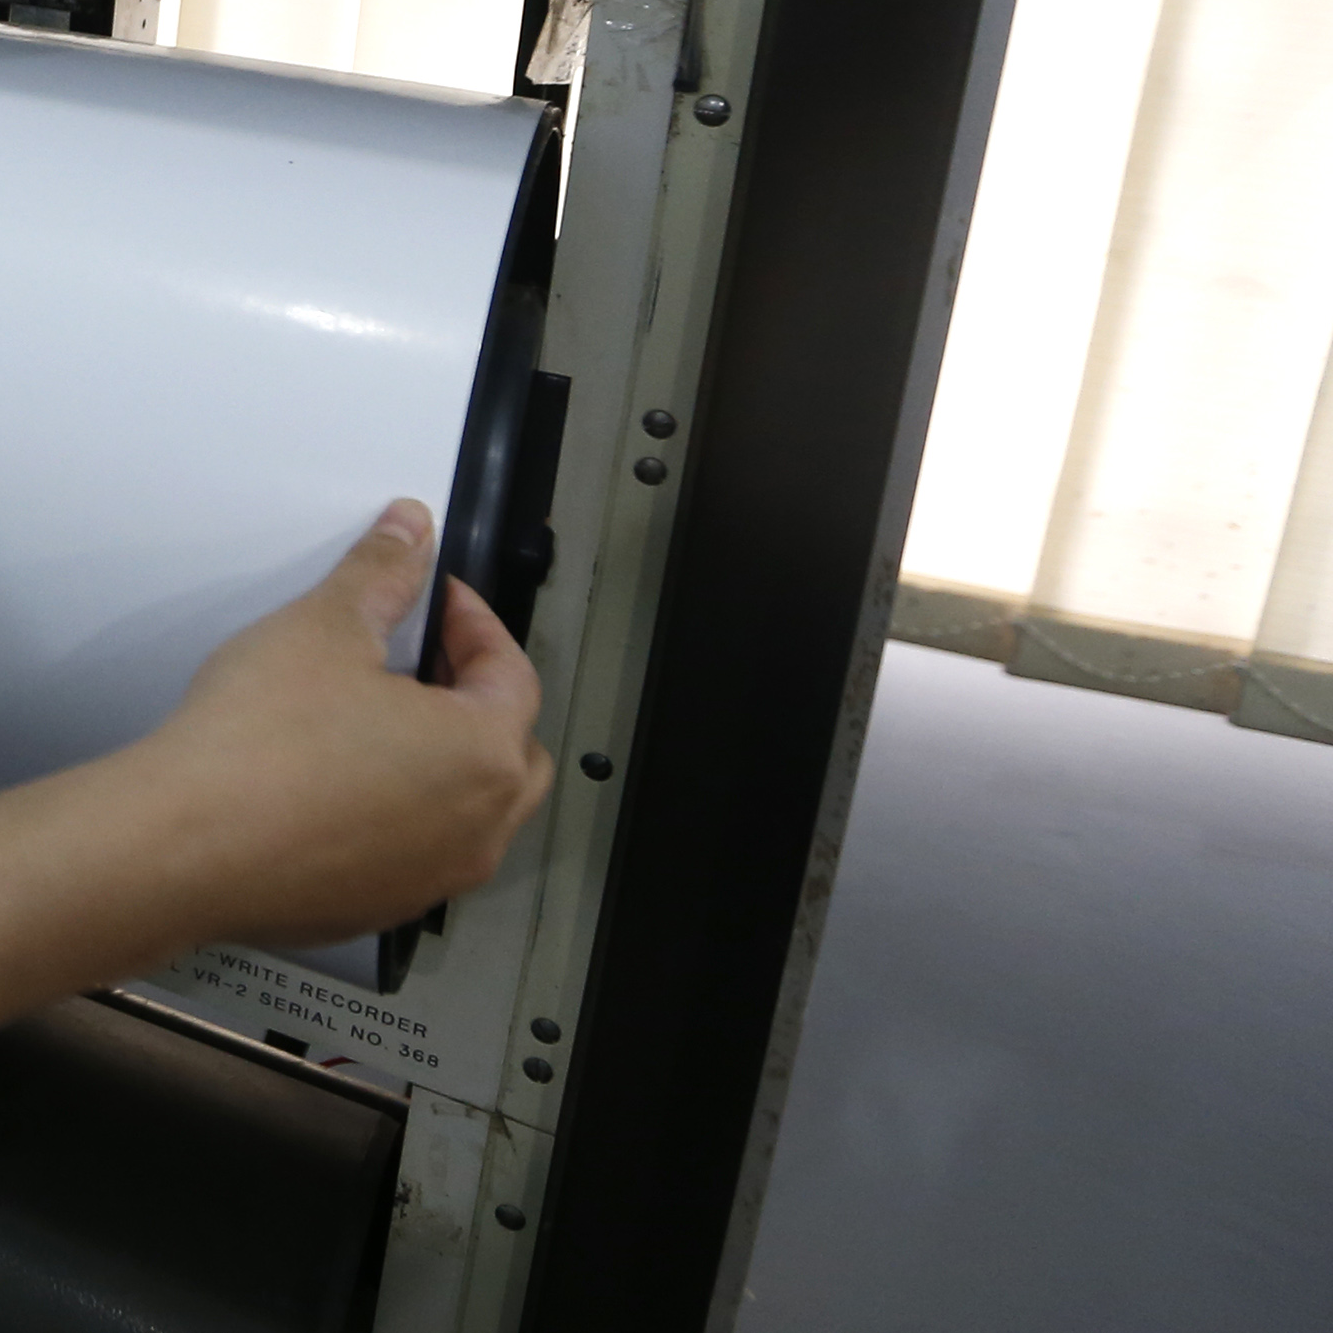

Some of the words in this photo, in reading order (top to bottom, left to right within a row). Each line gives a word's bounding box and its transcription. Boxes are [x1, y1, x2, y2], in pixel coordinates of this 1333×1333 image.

[193, 966, 248, 998] VR-2
[258, 991, 338, 1031] SERIAL
[350, 1024, 388, 1051] NO.
[398, 1042, 440, 1069] 368
[299, 981, 428, 1039] RECORDER
